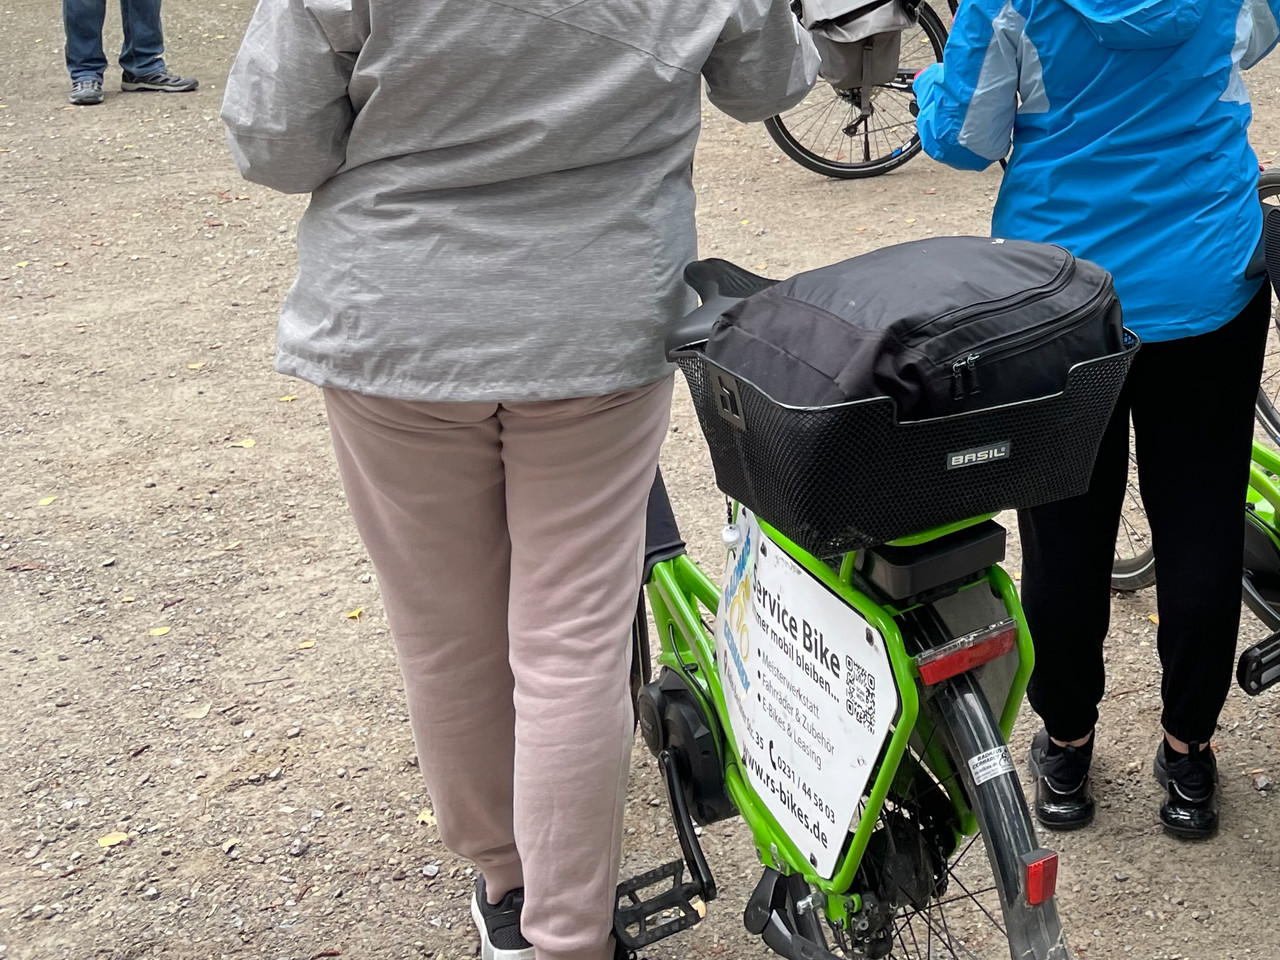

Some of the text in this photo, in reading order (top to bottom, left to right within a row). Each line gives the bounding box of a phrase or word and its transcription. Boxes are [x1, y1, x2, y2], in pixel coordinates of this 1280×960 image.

[752, 562, 841, 679] Service Bike
[770, 628, 794, 661] mobil
[762, 650, 820, 720] Meisterwerkstatt
[762, 673, 835, 756] Fahrräder & Zubehör
[755, 731, 764, 750] 35
[762, 696, 822, 771] E-Bikes & Leasing
[742, 740, 828, 849] www.rs-bikes.de
[777, 756, 795, 784] 0231
[802, 782, 812, 801] 44
[813, 793, 824, 812] 58
[825, 805, 836, 824] 03
